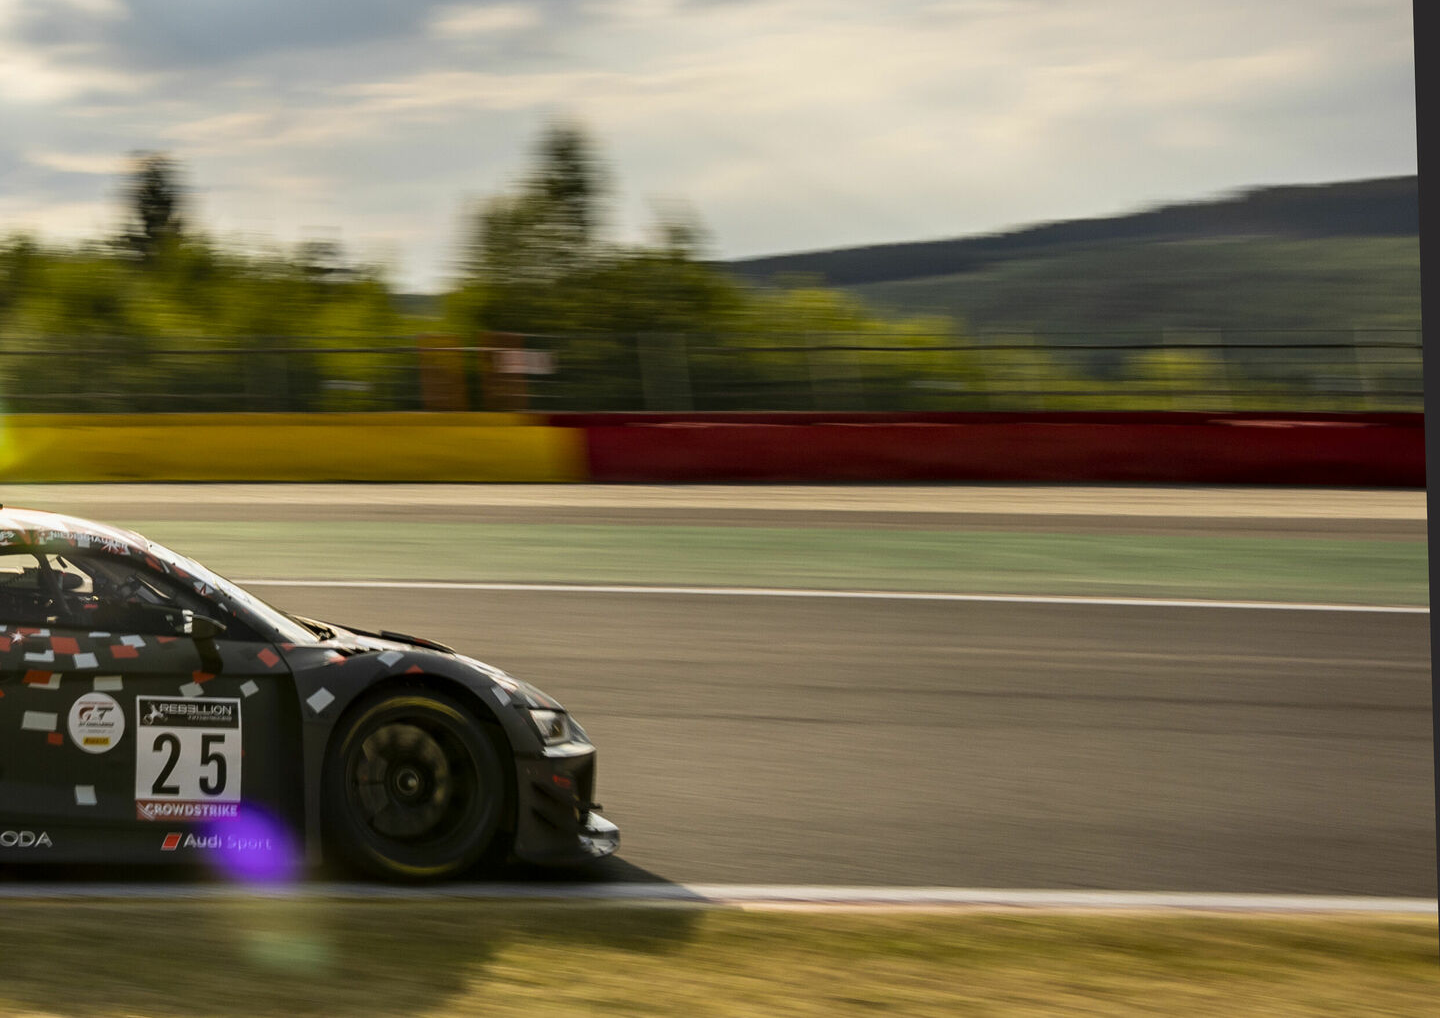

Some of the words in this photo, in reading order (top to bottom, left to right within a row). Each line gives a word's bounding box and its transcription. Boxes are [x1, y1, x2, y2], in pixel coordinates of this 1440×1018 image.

[159, 703, 232, 716] REBELLION
[152, 732, 228, 796] 25
[145, 802, 238, 818] CROWDSTRIKE
[183, 833, 222, 849] Audi
[227, 834, 272, 851] Sport
